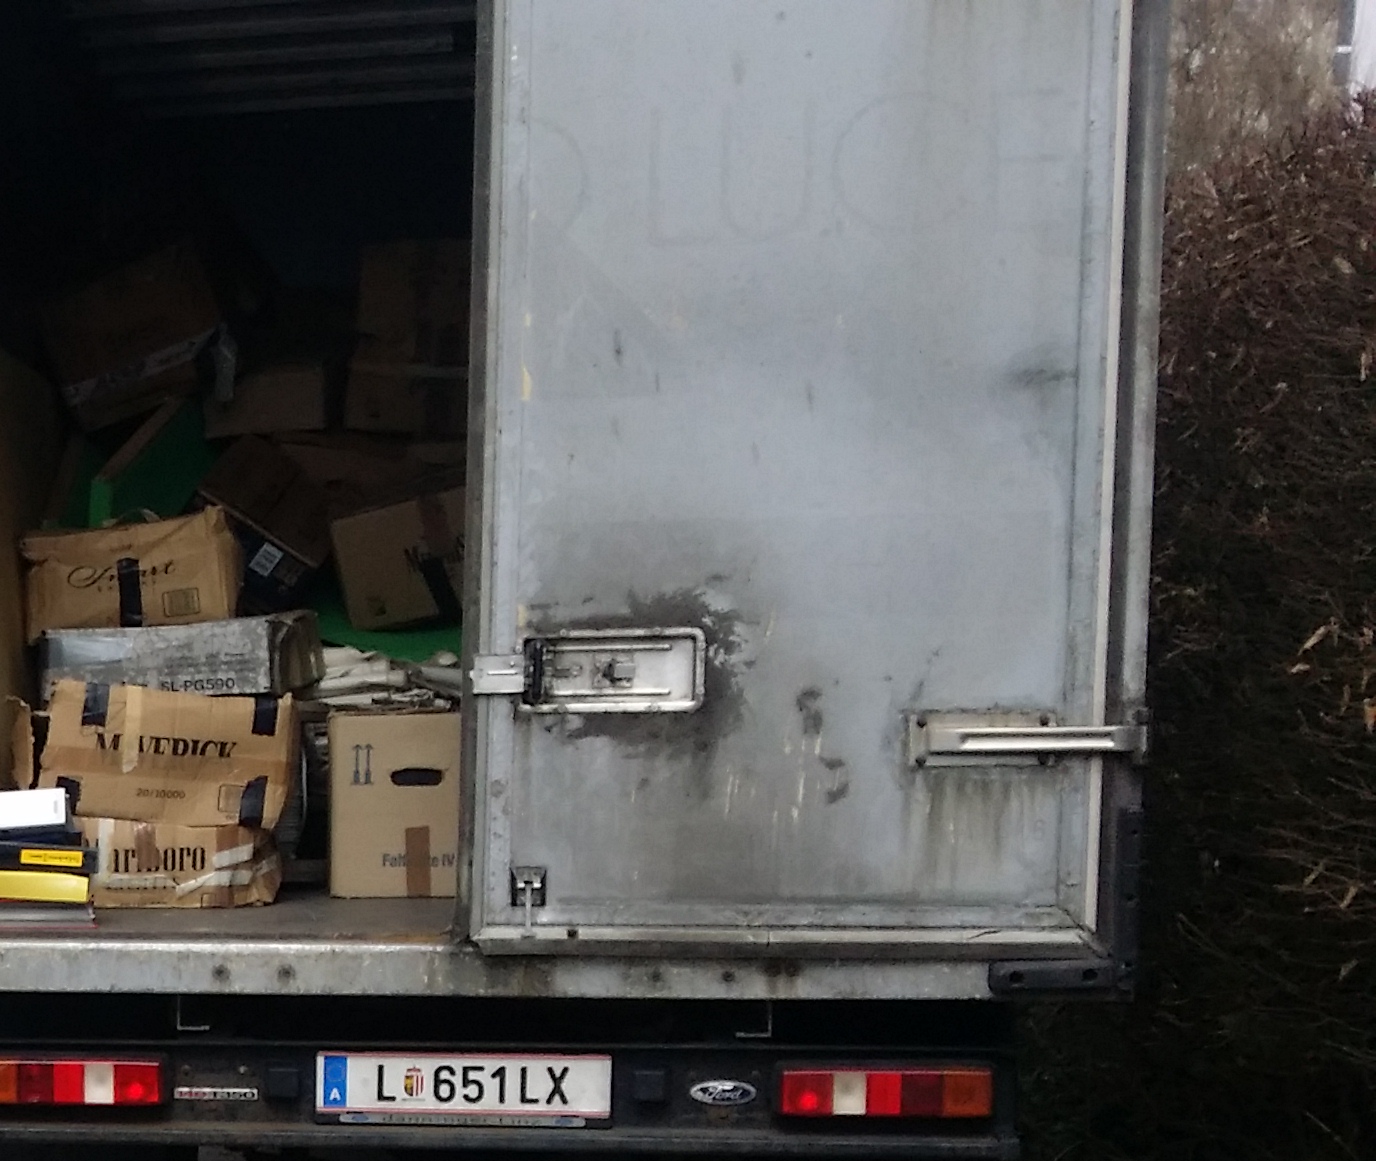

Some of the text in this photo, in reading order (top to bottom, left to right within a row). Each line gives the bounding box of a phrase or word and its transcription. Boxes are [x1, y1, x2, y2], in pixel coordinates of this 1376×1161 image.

[160, 677, 236, 693] SL-PG590
[95, 732, 238, 760] MVERICK
[376, 1064, 397, 1102] L
[698, 1083, 747, 1101] Ford
[328, 1087, 342, 1102] A
